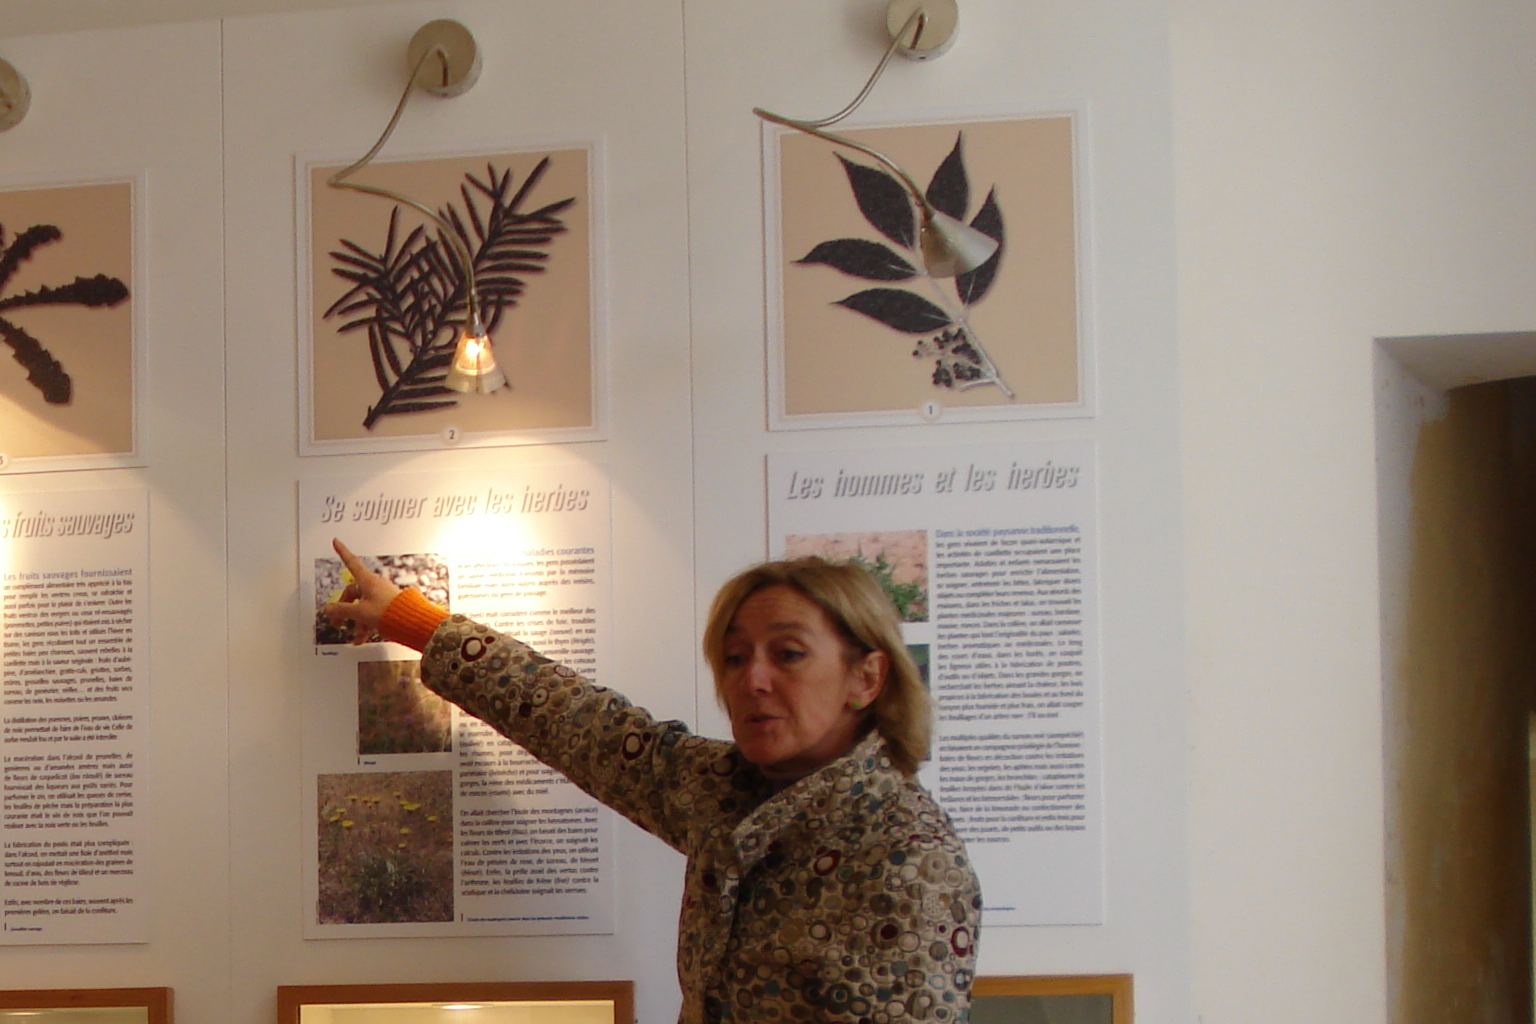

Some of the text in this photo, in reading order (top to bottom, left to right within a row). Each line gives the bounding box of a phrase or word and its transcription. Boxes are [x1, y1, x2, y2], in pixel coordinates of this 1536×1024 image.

[449, 430, 455, 440] 2
[786, 460, 1081, 500] Les hommes et les herbes
[321, 484, 591, 525] Se soigner avec les herbes
[12, 510, 56, 538] fruits
[58, 512, 136, 540] sauvages
[556, 546, 595, 556] courantes
